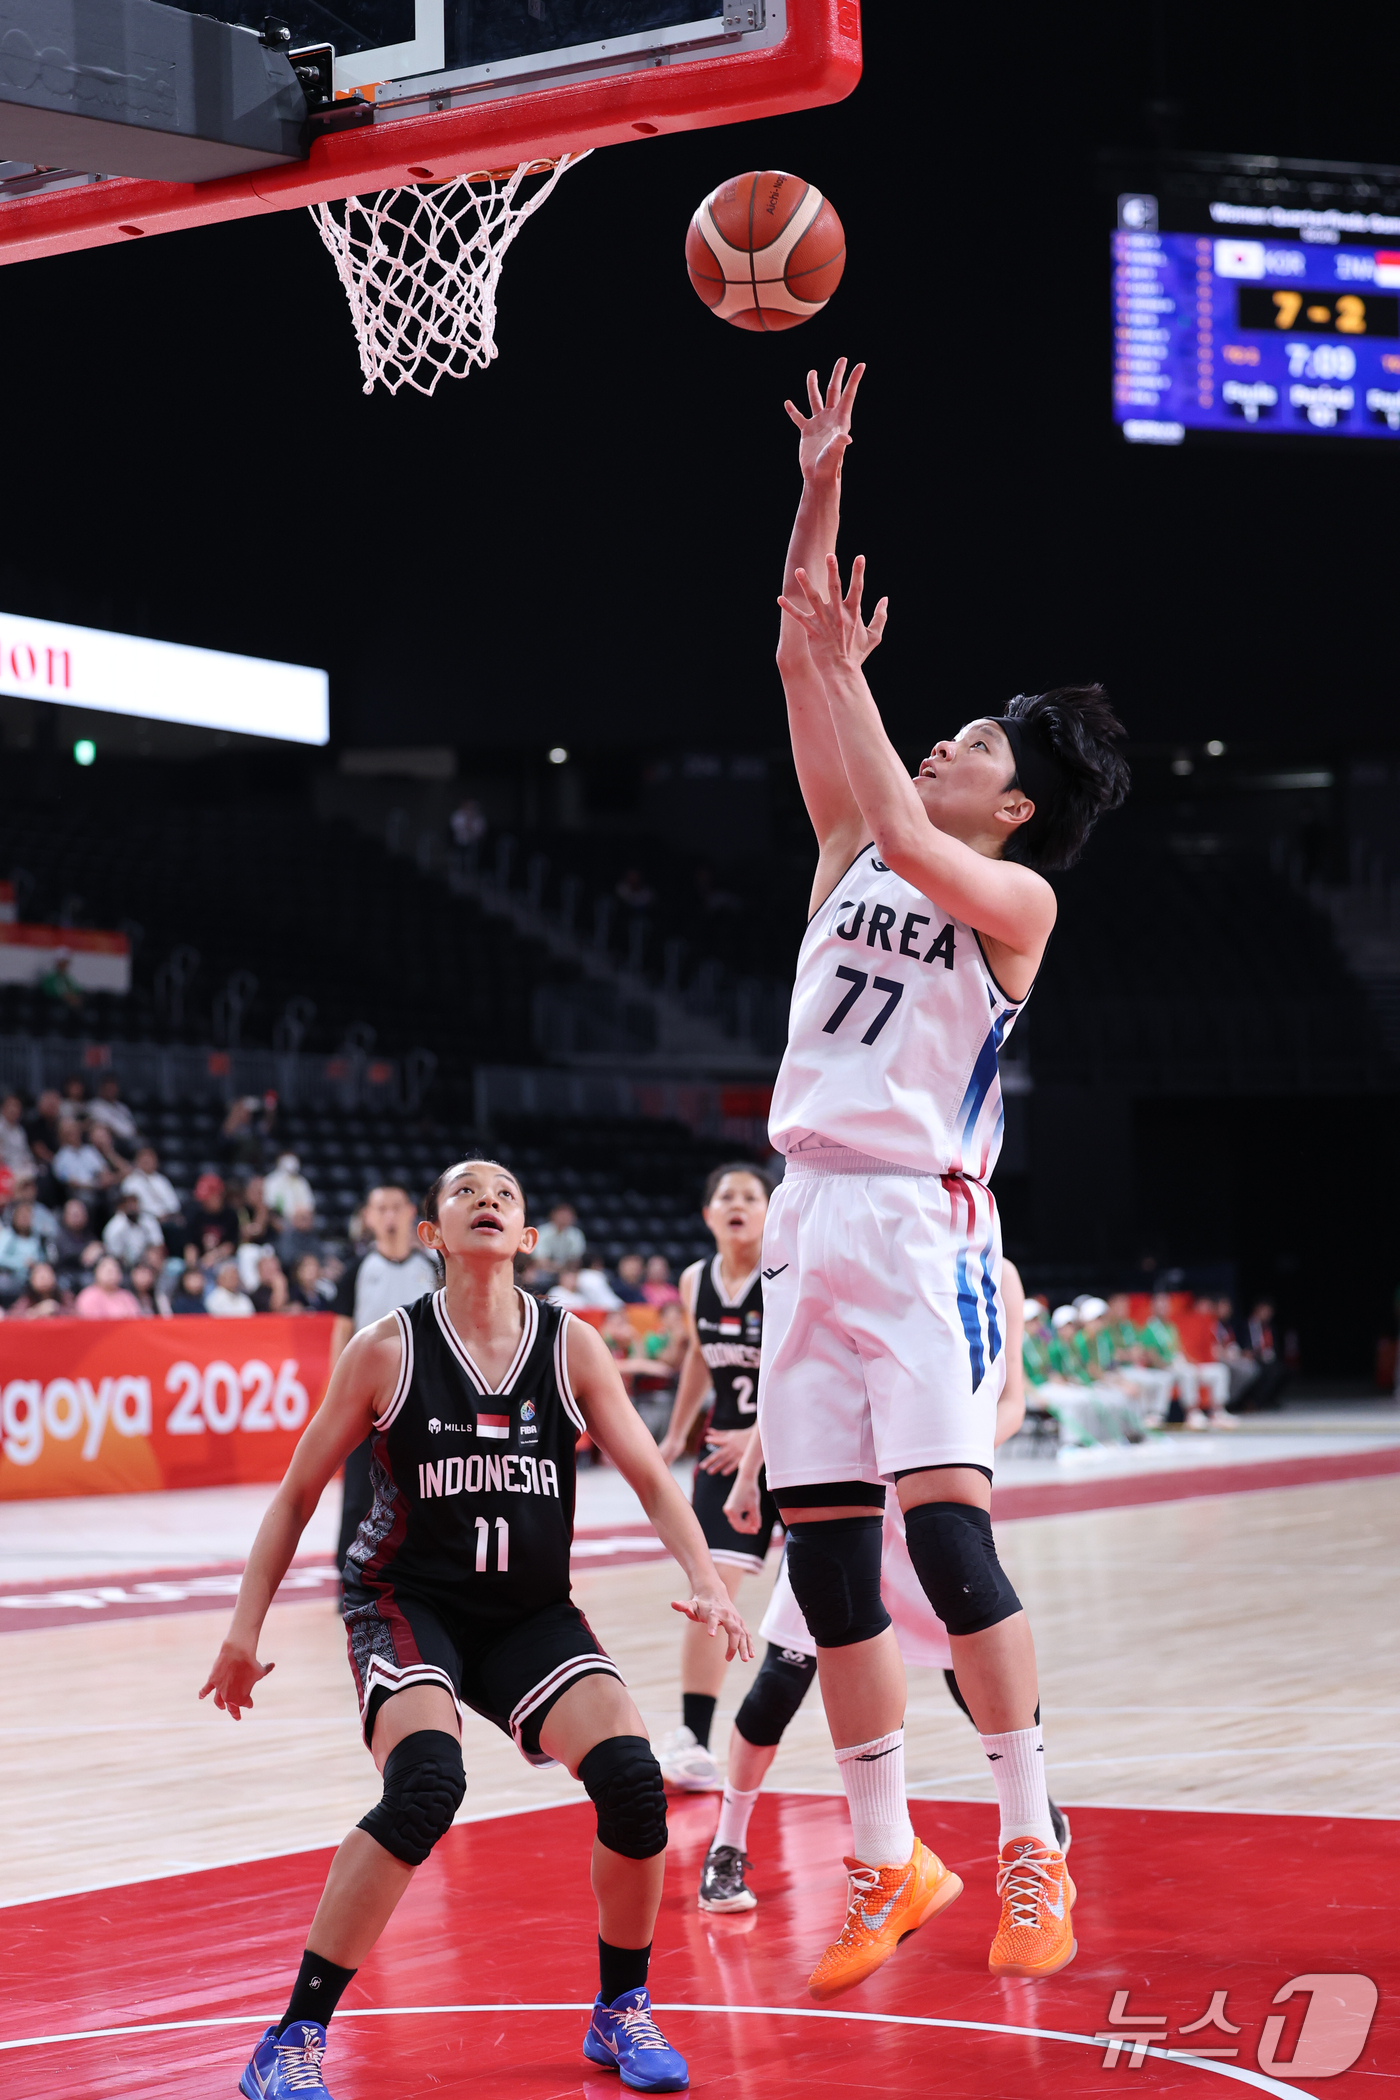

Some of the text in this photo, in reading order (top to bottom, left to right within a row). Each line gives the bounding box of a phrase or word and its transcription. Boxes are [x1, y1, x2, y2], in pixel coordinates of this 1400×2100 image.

[0, 641, 72, 690] on
[828, 900, 957, 971] OREA
[822, 964, 905, 1046] 77
[0, 1358, 310, 1466] goya 2026
[444, 1422, 473, 1432] MILLS
[519, 1424, 538, 1436] FIBA
[418, 1454, 560, 1499] INDONESIA
[474, 1516, 510, 1573] 11
